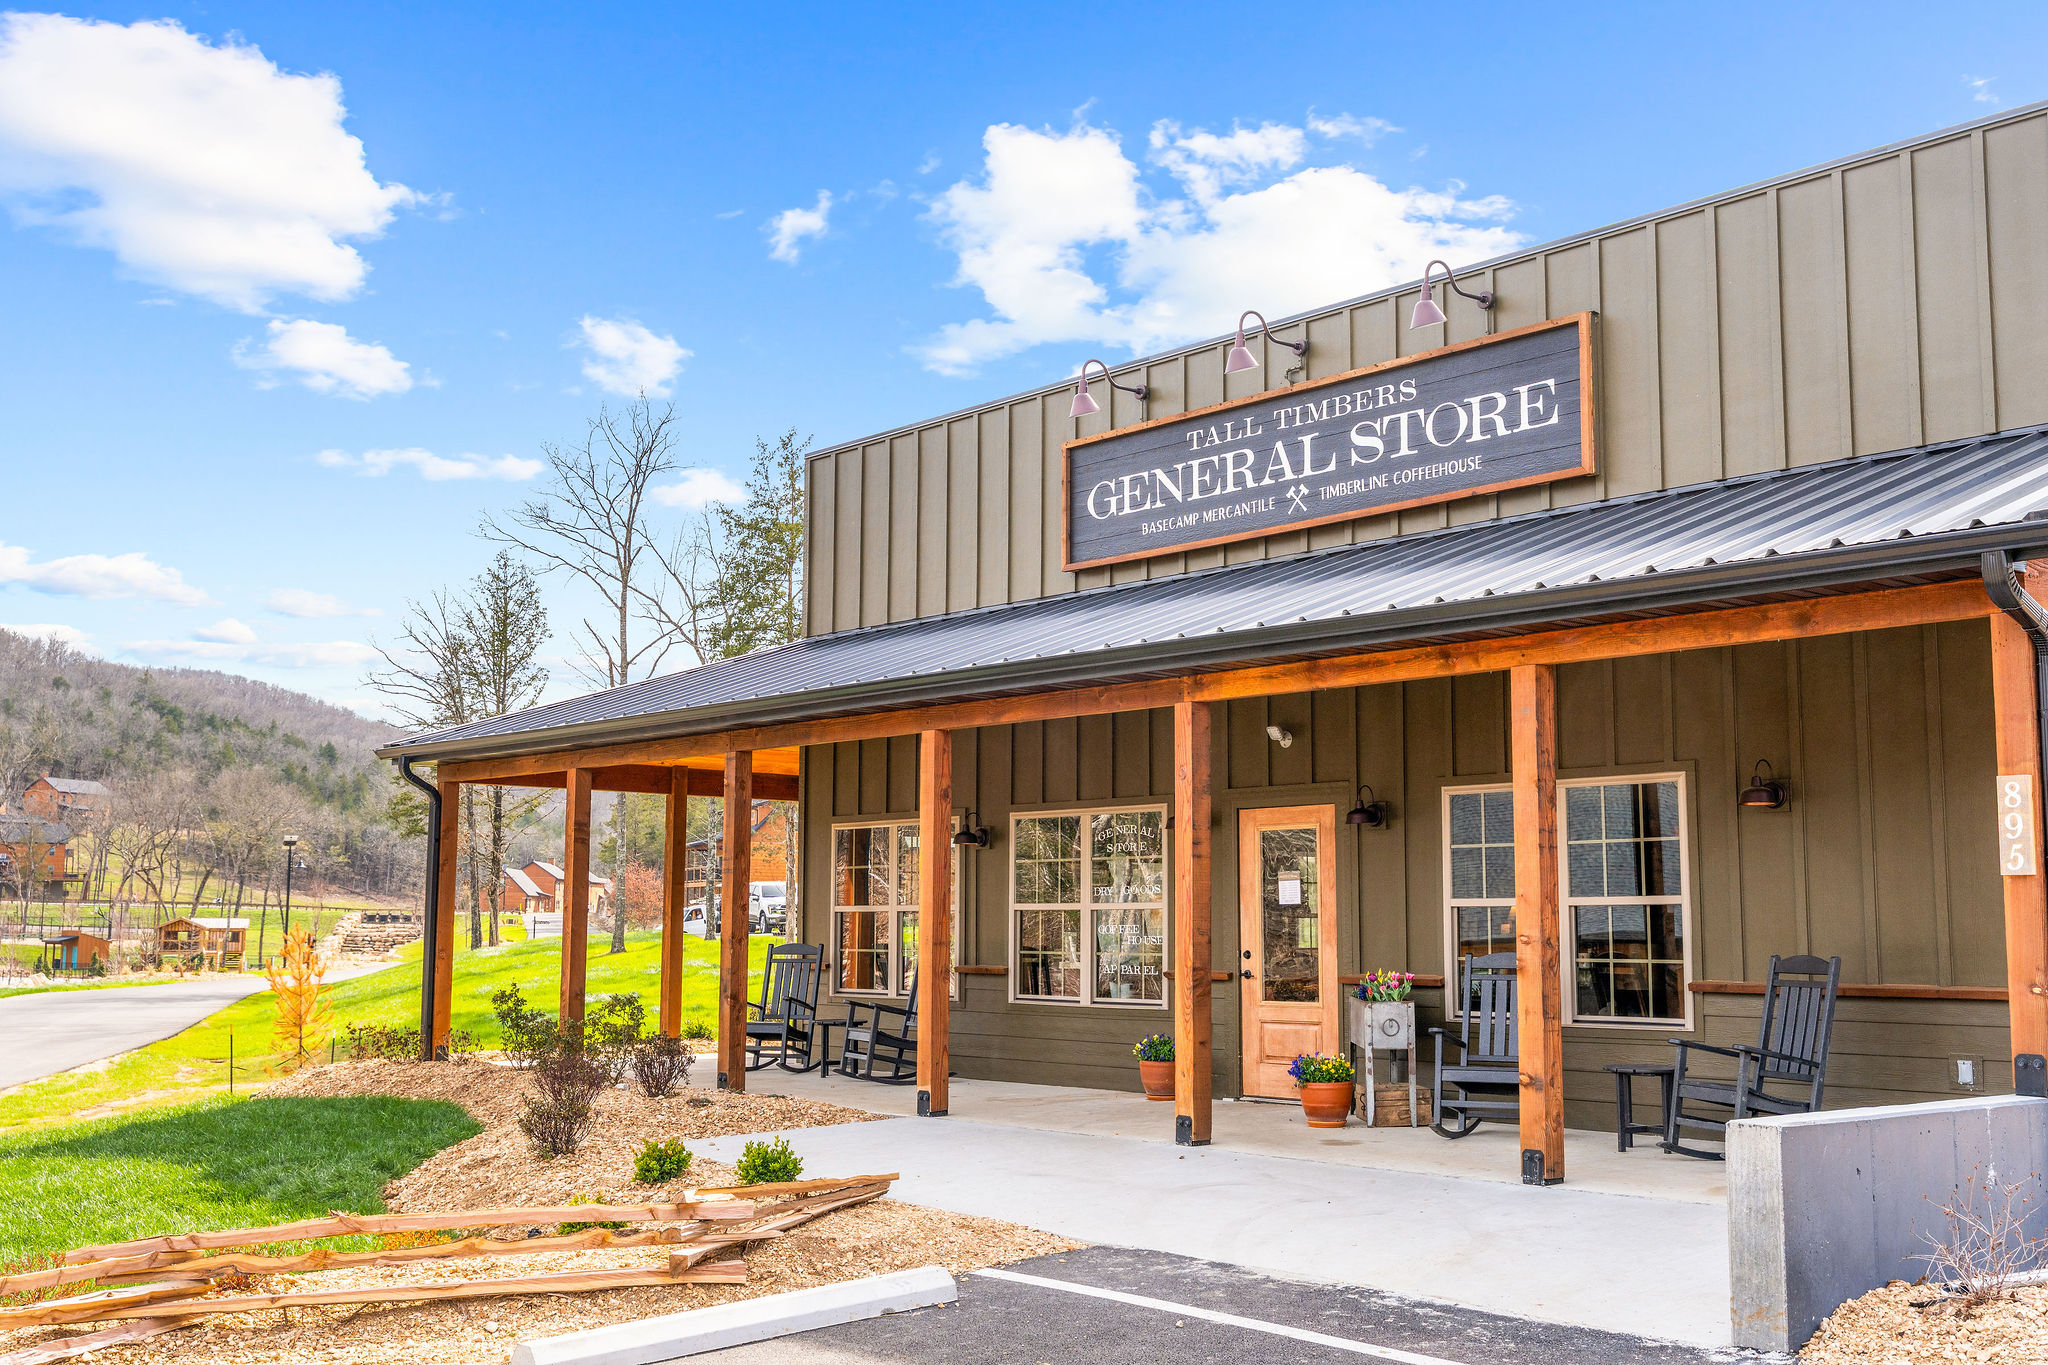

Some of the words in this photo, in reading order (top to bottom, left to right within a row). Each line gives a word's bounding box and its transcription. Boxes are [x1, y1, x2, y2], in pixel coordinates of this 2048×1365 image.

[1187, 416, 1262, 451] TALL
[1273, 378, 1417, 430] TIMBERS
[1087, 432, 1336, 520] GENERAL
[1350, 378, 1559, 467] STORE
[1319, 473, 1388, 500] TIMBERLINE
[1393, 455, 1482, 485] COFFEEHOUSE
[1142, 512, 1199, 535] BASECAMP
[1202, 496, 1276, 524] MERCANTILE
[1098, 825, 1155, 842] GENERAL
[2004, 781, 2024, 871] 895
[1107, 842, 1148, 853] STORE
[1093, 886, 1113, 897] DRY
[1123, 884, 1161, 895] GOODS
[1127, 935, 1163, 945] HOUSE
[1103, 964, 1159, 976] APPAREL
